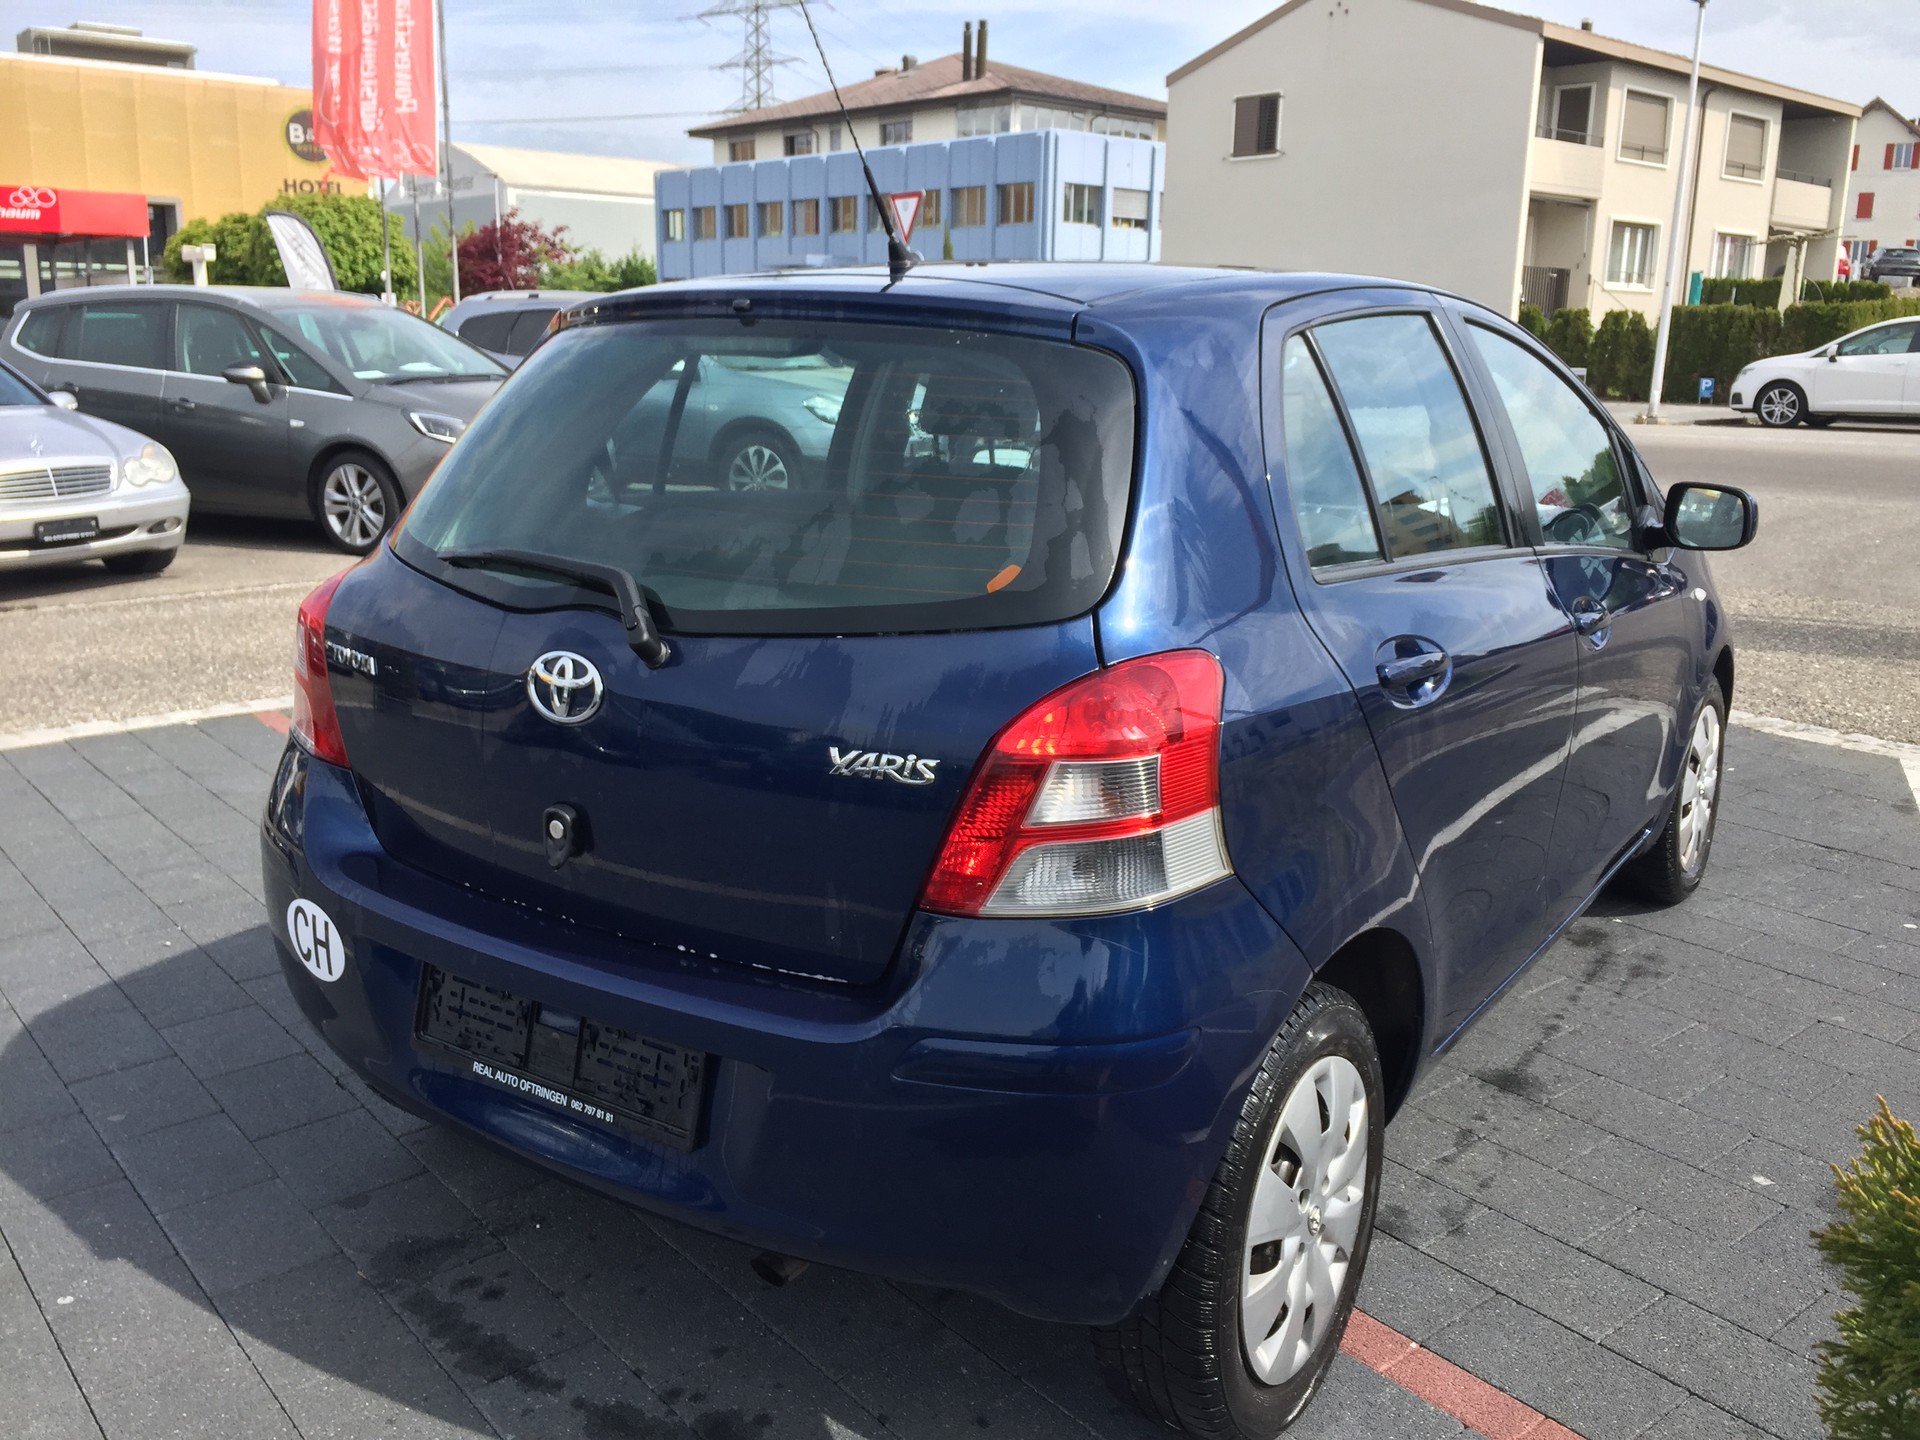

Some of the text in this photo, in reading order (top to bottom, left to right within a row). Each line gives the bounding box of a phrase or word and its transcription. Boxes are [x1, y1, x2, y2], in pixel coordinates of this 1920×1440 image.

[1701, 379, 1713, 391] P
[325, 640, 378, 676] TOYOTA
[293, 905, 333, 977] CH
[472, 1061, 614, 1123] REAL AUTO OFTRINGEN 062 797 81 81
